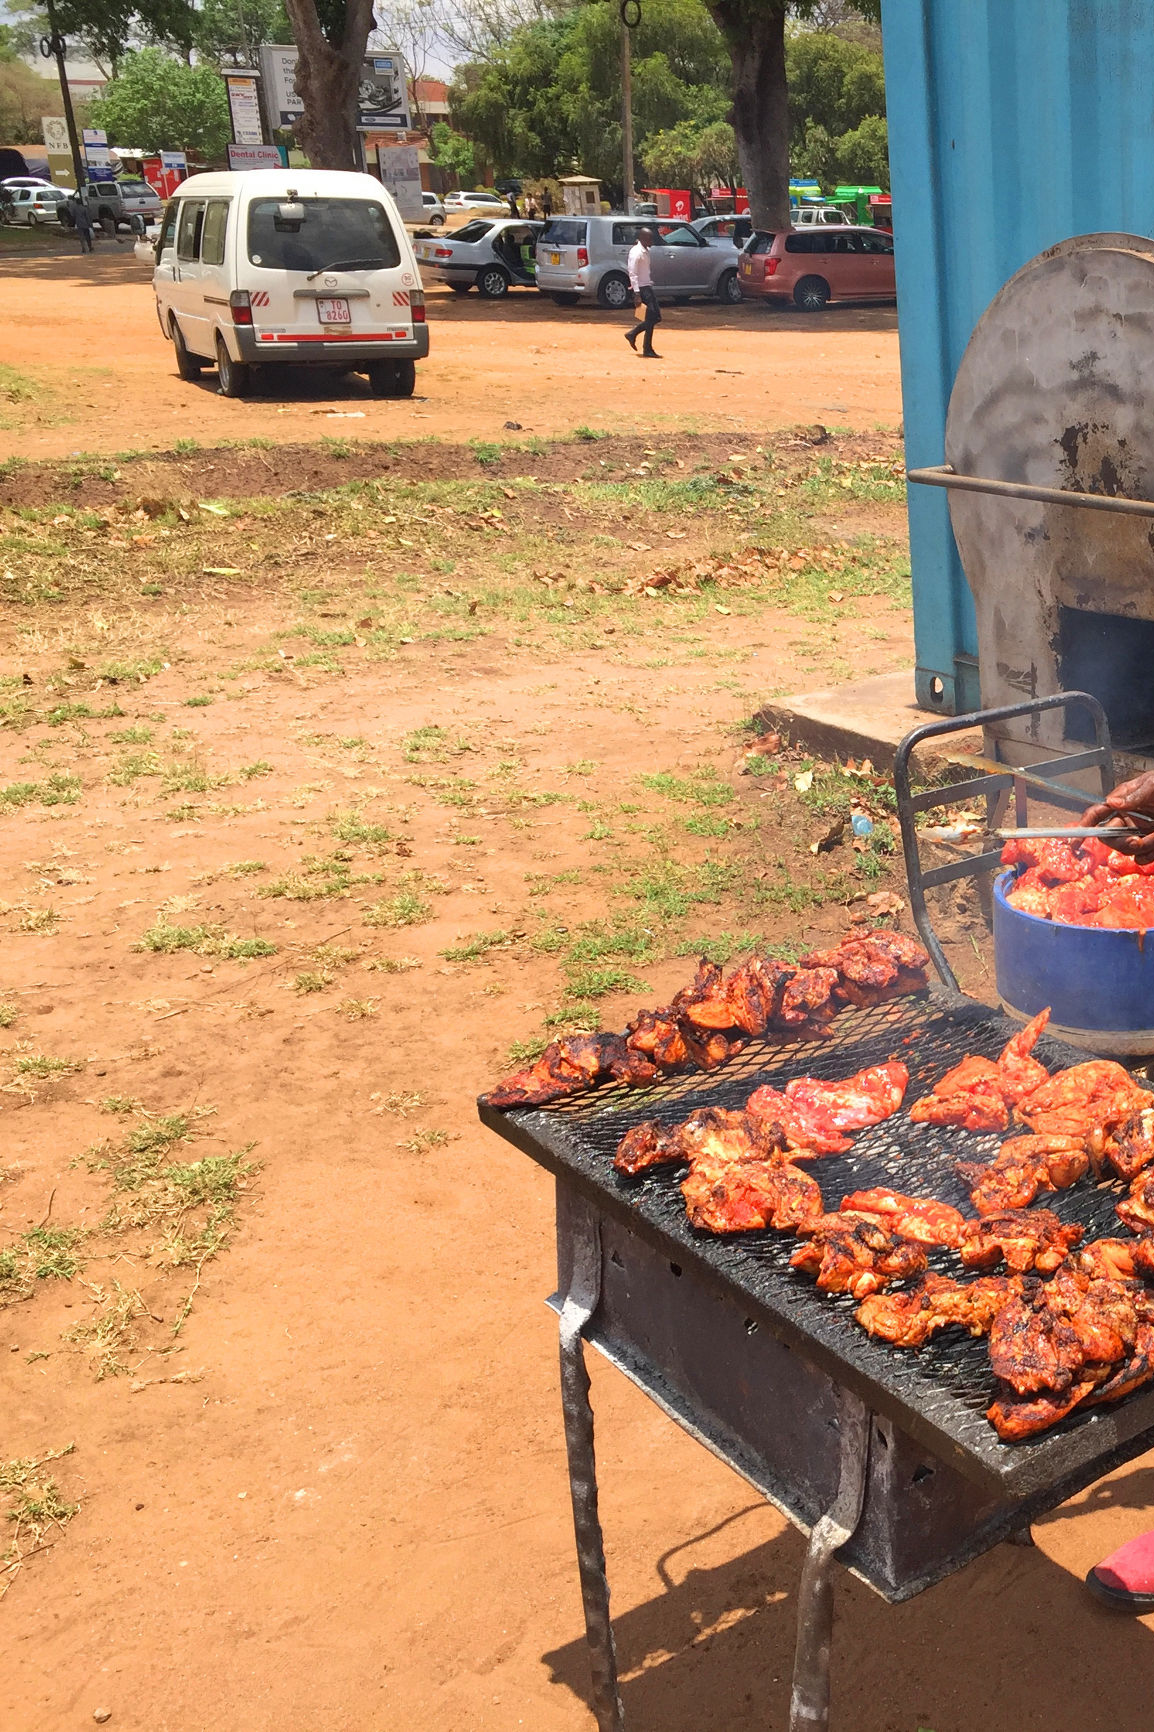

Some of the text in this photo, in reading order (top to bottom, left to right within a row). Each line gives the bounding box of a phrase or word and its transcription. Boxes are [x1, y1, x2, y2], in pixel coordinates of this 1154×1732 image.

[49, 142, 69, 150] NFB
[257, 151, 279, 159] Clinic
[326, 310, 349, 321] 8260
